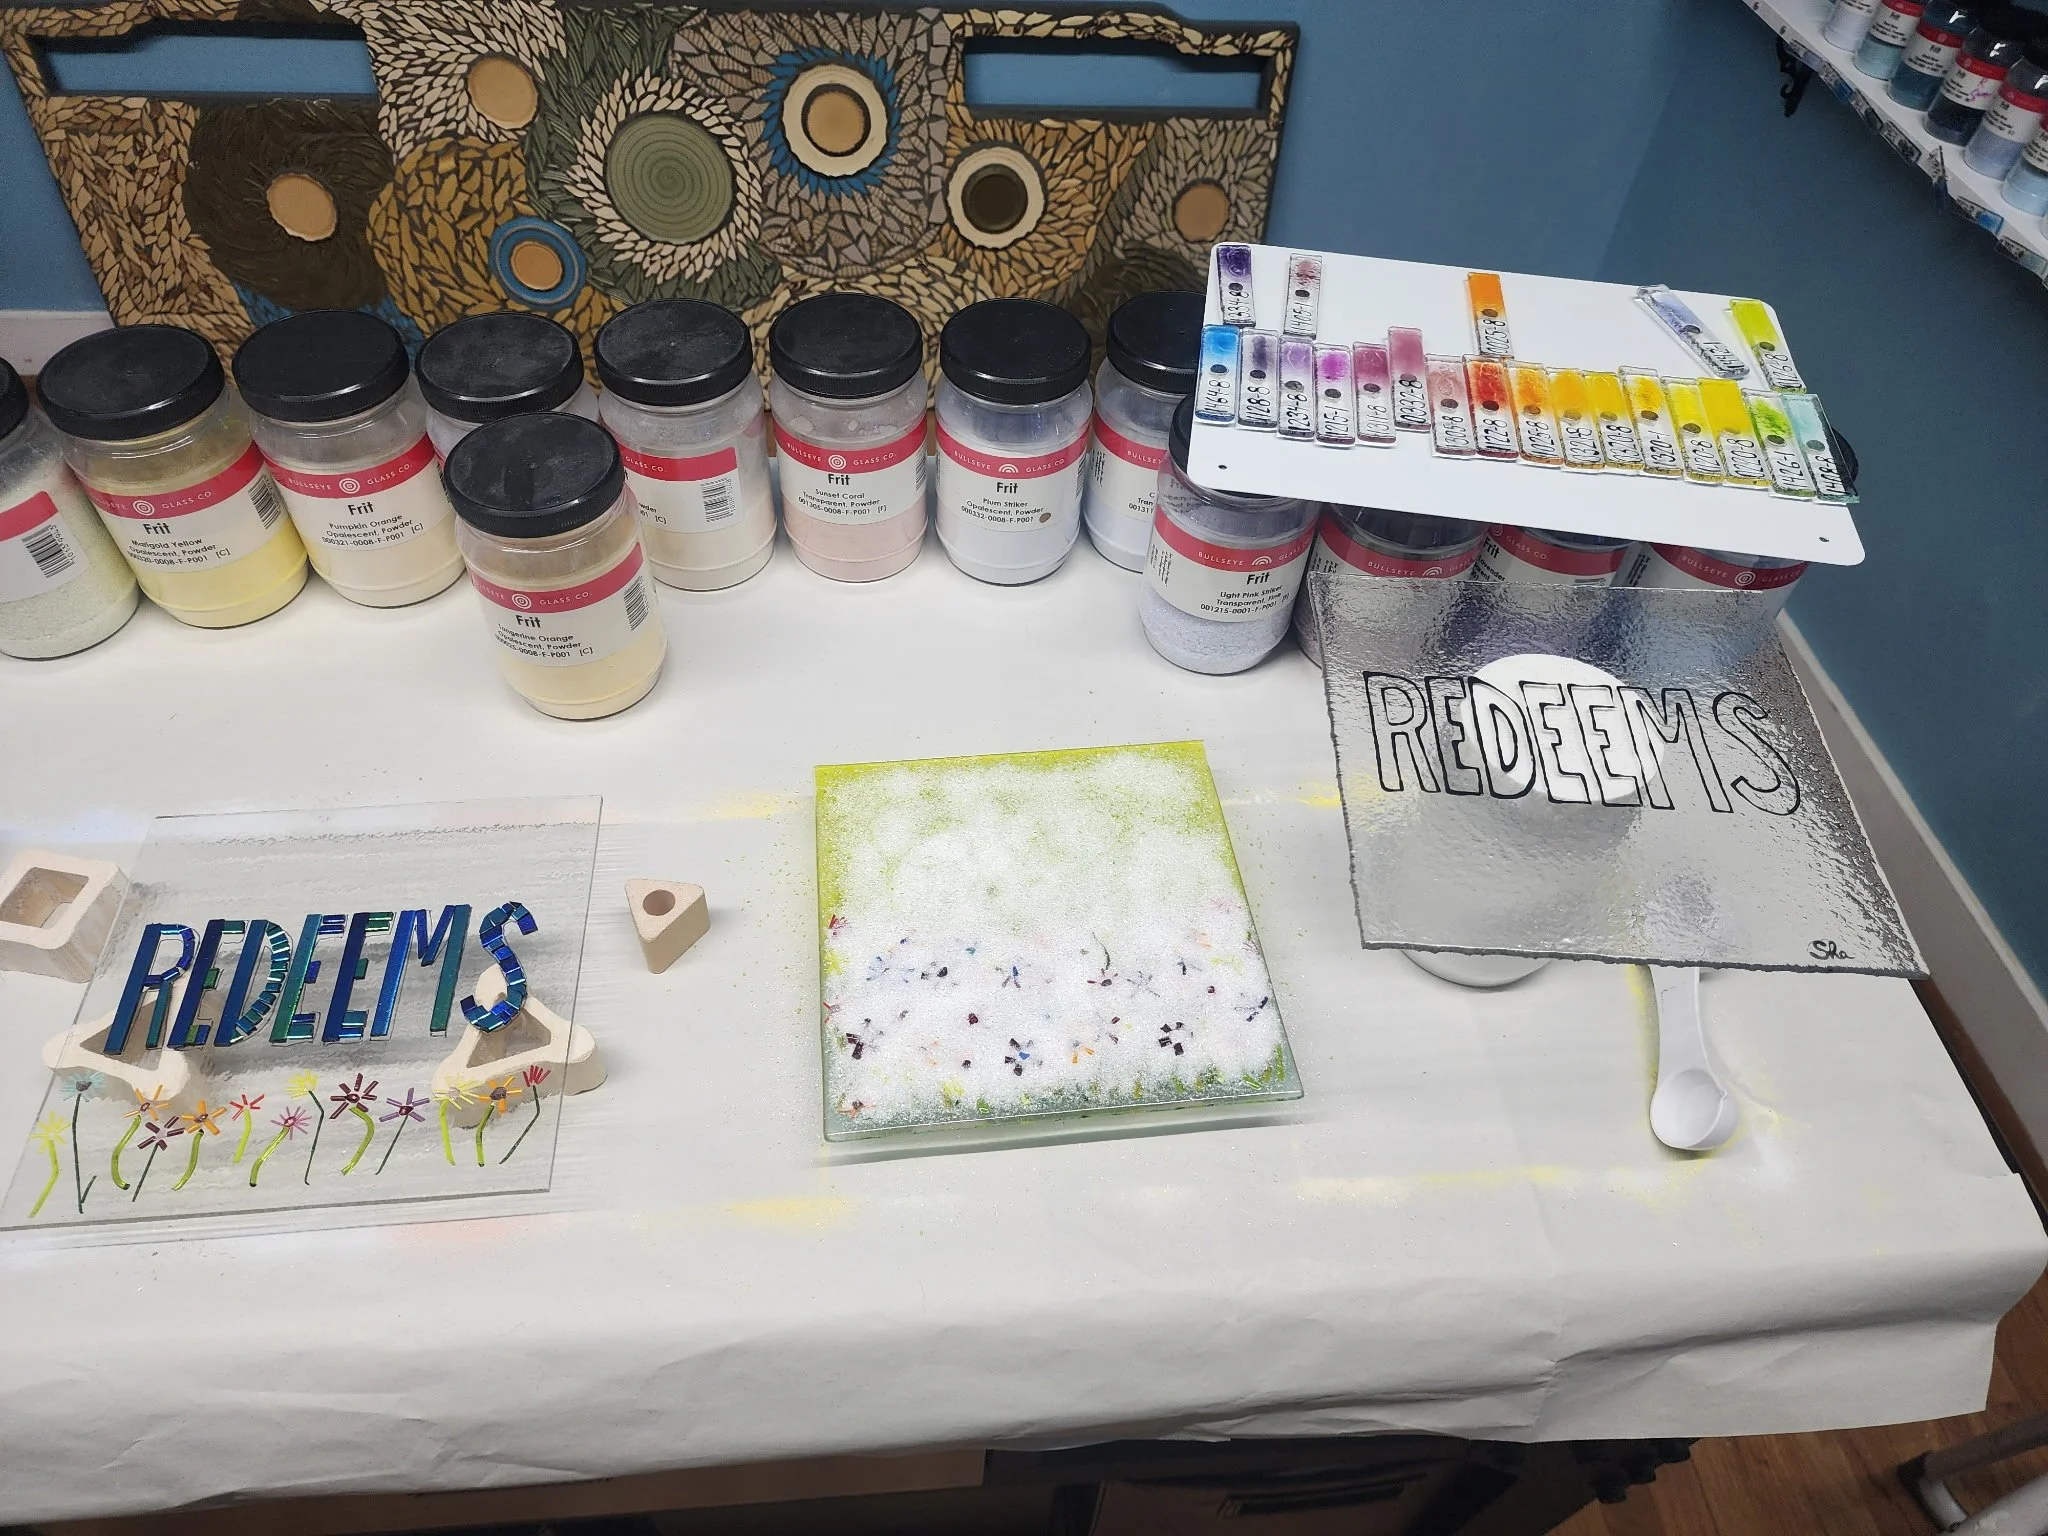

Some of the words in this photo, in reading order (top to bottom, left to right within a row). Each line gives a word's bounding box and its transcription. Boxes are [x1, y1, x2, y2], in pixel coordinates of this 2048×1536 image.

[1203, 378, 1231, 414] 1464-8
[1245, 385, 1272, 423] 1128-8
[1398, 378, 1427, 424] 0332-8
[1285, 392, 1311, 431] 1234-8
[1323, 404, 1349, 437] 1215-1
[1441, 414, 1470, 449] 1305-8
[1482, 417, 1512, 452] 1122-8
[1525, 419, 1558, 457] 1025-8
[787, 442, 822, 463] BULLSEYE
[853, 455, 880, 466] GLASS
[1647, 429, 1677, 467] 1320-1
[625, 456, 649, 469] GLASS
[954, 450, 992, 471] BULLSEYE
[1025, 462, 1052, 473] GLASS
[1127, 450, 1162, 464] BULLSEY
[1772, 449, 1809, 489] 1426-1
[288, 477, 331, 490] BULLSEYE
[367, 471, 396, 485] GLASS
[827, 473, 851, 486] Frit
[996, 481, 1019, 494] Frit
[815, 488, 840, 499] Sunset
[842, 492, 865, 500] Coral
[162, 497, 194, 509] GLASS
[347, 501, 374, 516] Frit
[850, 499, 880, 508] Powder
[983, 497, 1002, 507] Plum
[1003, 500, 1028, 508] Striker
[1015, 507, 1044, 516] Powder
[143, 522, 171, 535] Frit
[326, 529, 380, 539] Opalescent,
[381, 519, 413, 533] Powder
[328, 521, 368, 531] Pumpkin
[370, 514, 403, 528] Orange
[131, 539, 170, 550] Marigold
[171, 538, 203, 548] Yellow
[182, 544, 217, 556] Powder
[1483, 536, 1500, 559] Frit
[1506, 535, 1530, 553] GLASS
[1198, 551, 1244, 566] BULLSEYE
[1681, 555, 1729, 578] BULLSEYE
[1367, 561, 1415, 576] BULLSEYE
[1246, 571, 1270, 585] Frit
[1220, 591, 1241, 600] Light
[1242, 591, 1260, 599] Pink
[1261, 584, 1283, 597] Striker
[1267, 592, 1282, 602] Fine
[539, 596, 571, 606] GLASS
[515, 614, 541, 629] Frit
[497, 622, 536, 641] Tangerine
[538, 634, 574, 644] Orange
[547, 642, 581, 651] Powder
[580, 646, 594, 657] [C]
[1361, 670, 1803, 817] REDEEMS
[103, 901, 539, 1056] REDEEMS
